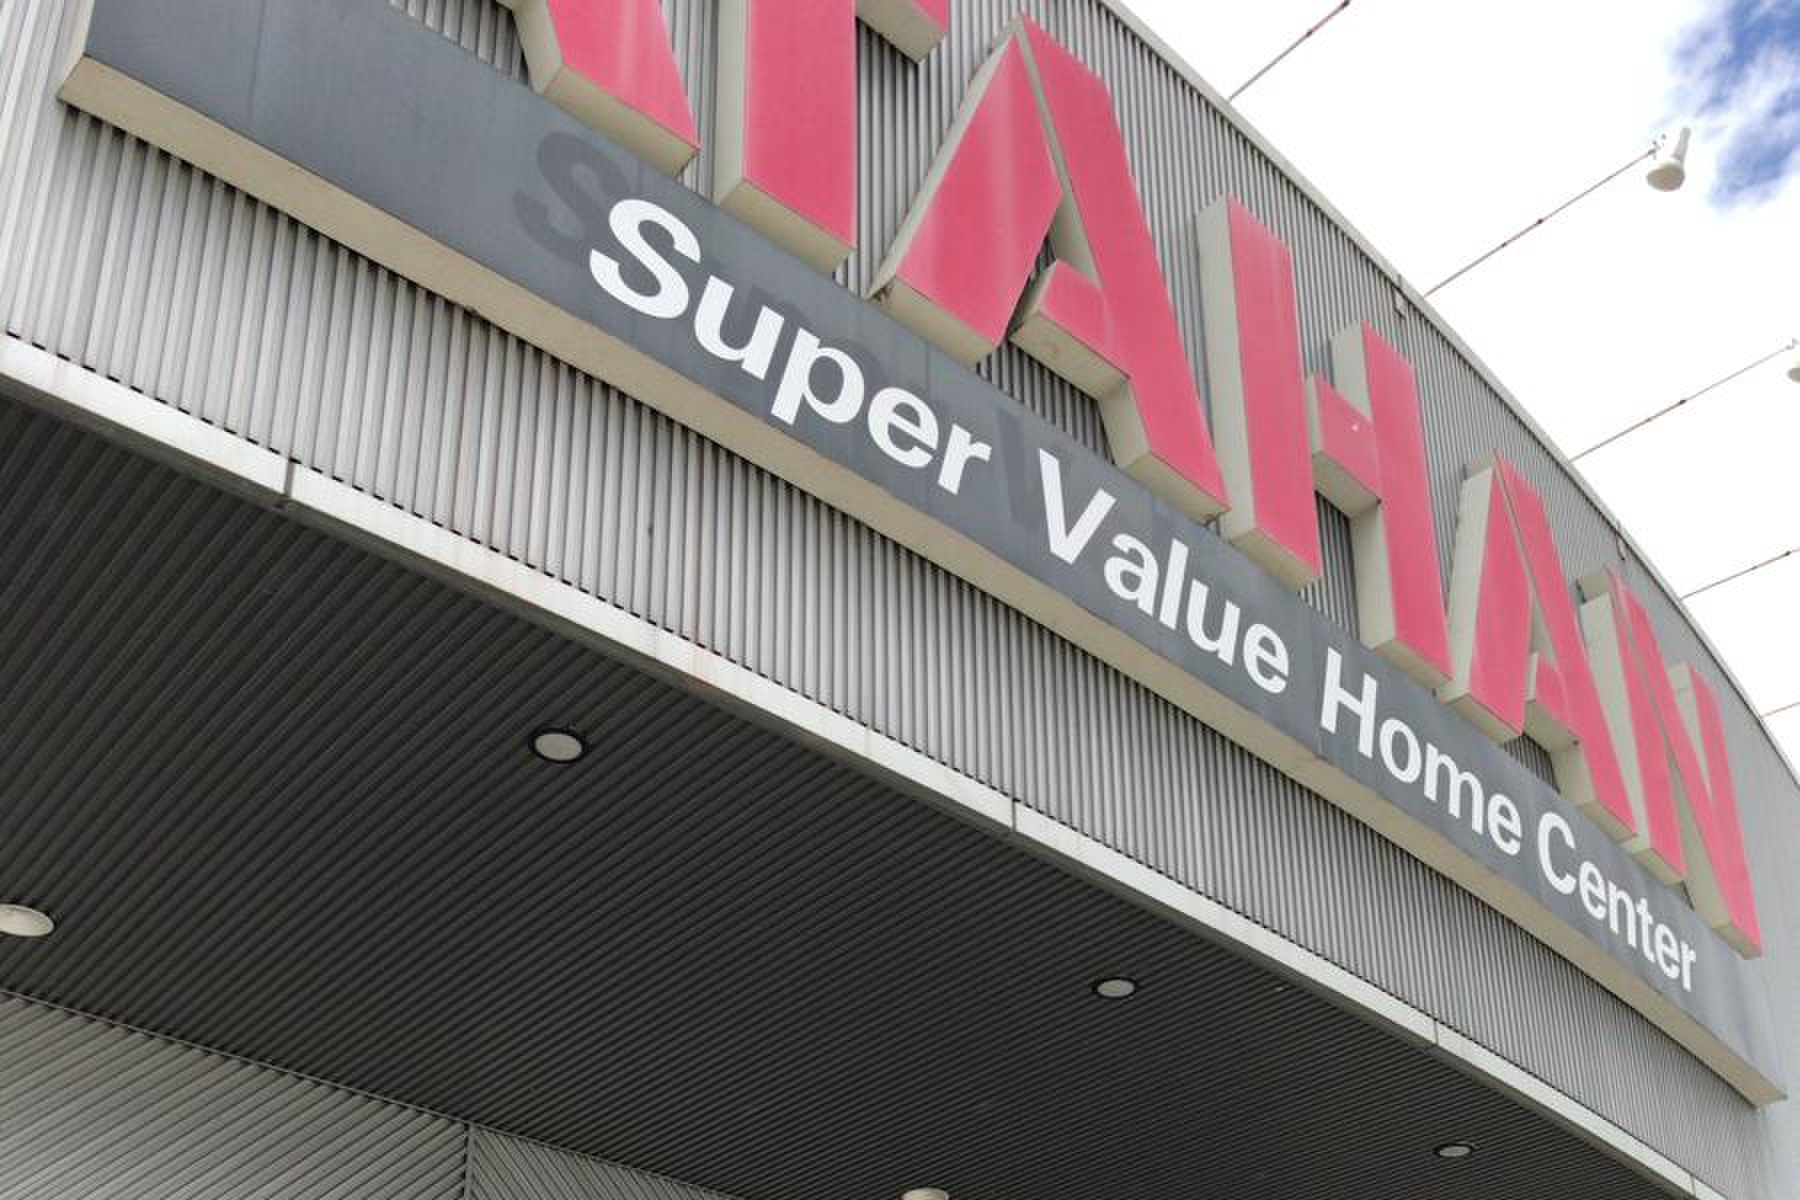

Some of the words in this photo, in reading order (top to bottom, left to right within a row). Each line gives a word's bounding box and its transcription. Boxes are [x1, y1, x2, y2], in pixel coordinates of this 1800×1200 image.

[589, 198, 992, 495] Super
[1037, 448, 1290, 696] Value
[1319, 645, 1523, 856] Home
[1537, 811, 1697, 994] Center
